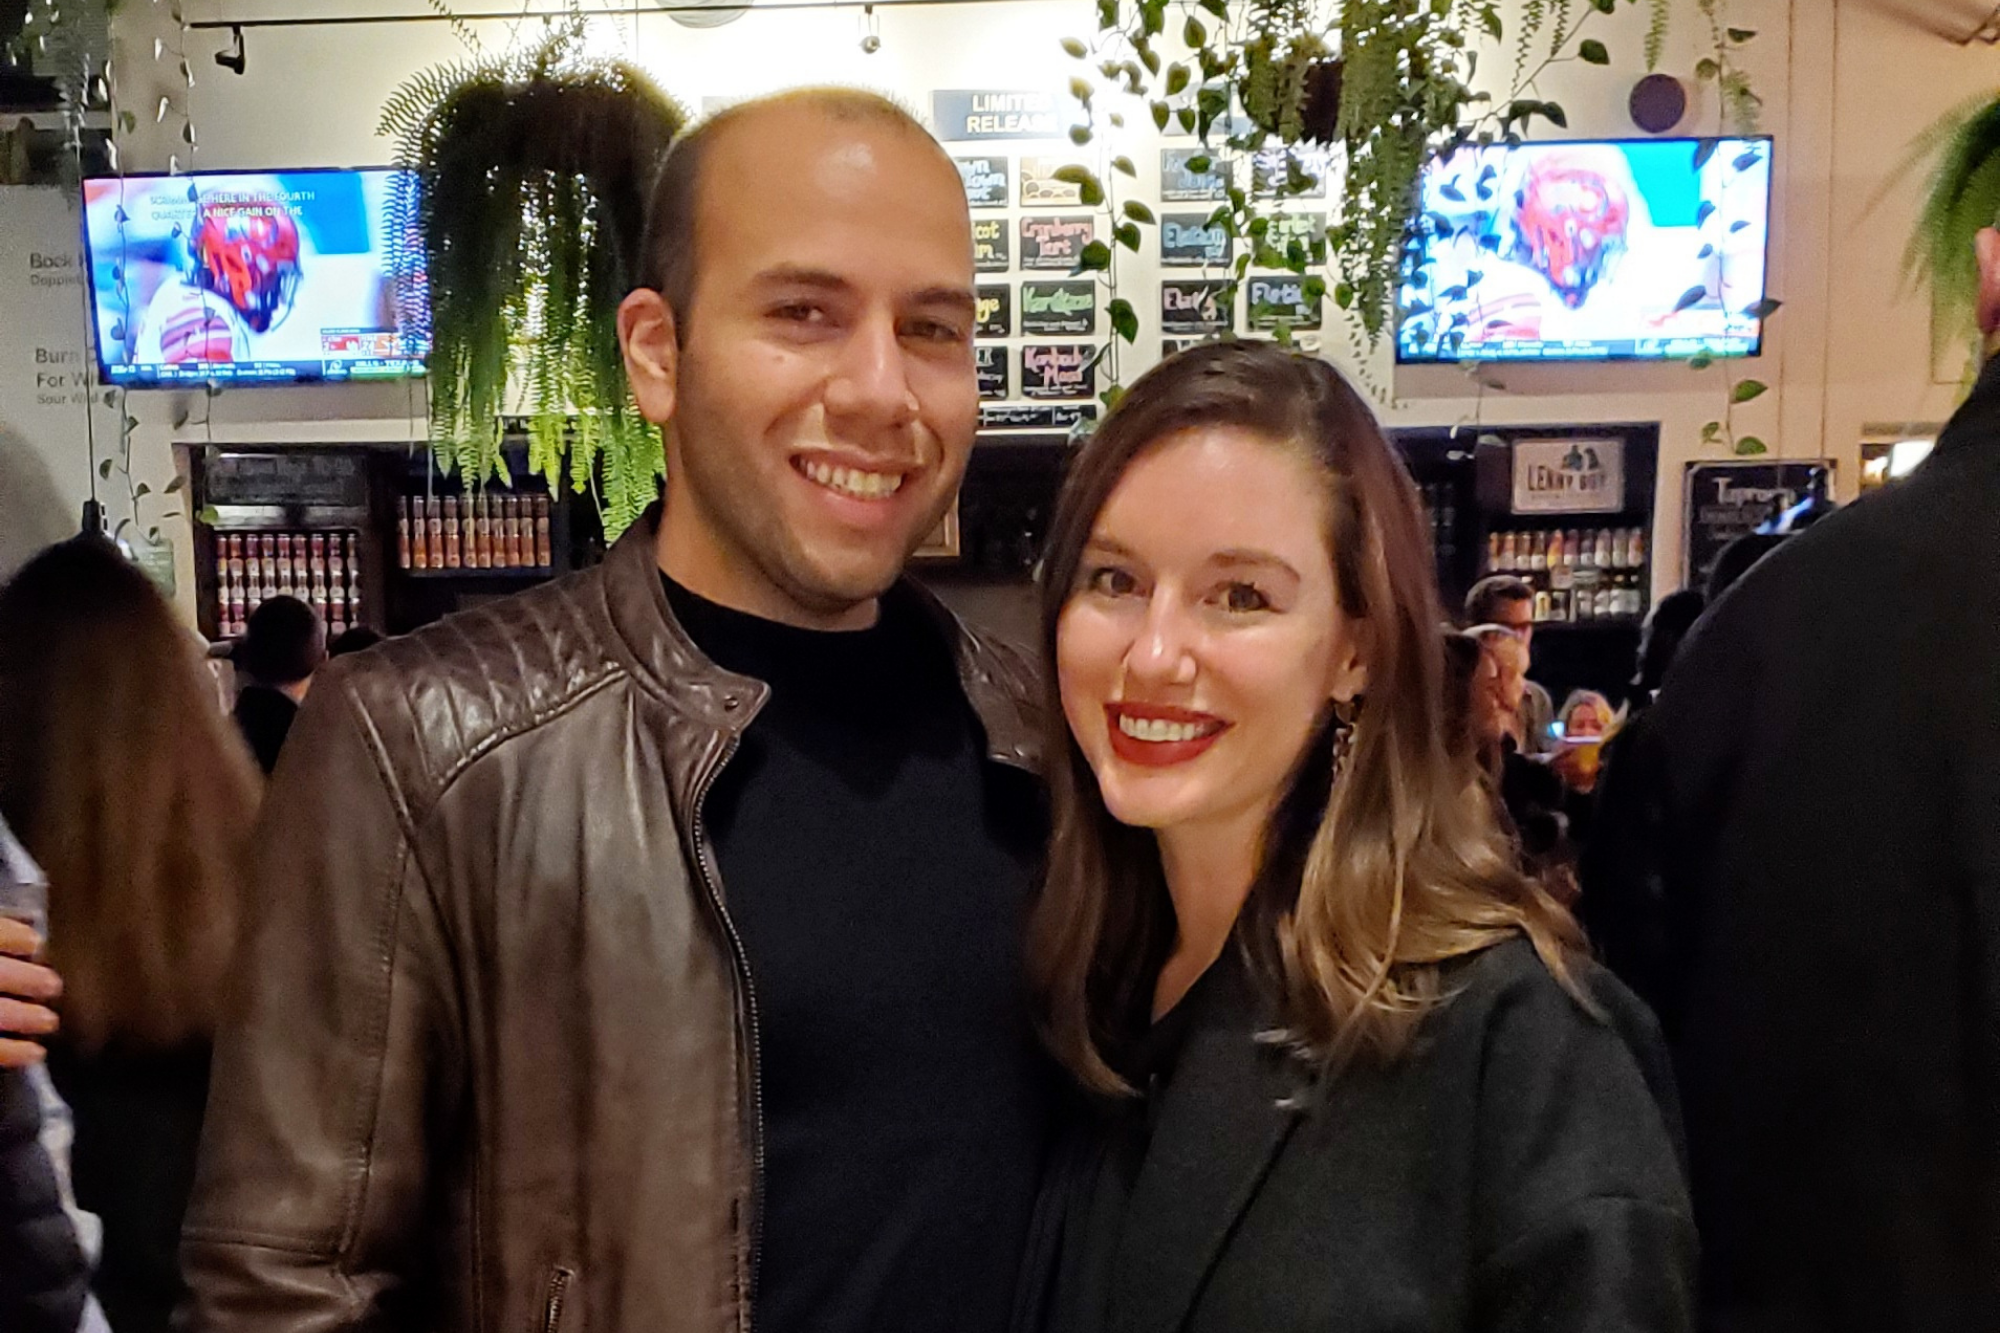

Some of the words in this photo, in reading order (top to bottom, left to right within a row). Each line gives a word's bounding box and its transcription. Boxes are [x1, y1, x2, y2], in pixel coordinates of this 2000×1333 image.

[973, 93, 1054, 113] LIMITED
[966, 114, 1059, 134] RELEASE
[275, 190, 316, 202] FOURTH
[238, 207, 264, 218] GAIN
[284, 205, 303, 216] THE
[36, 371, 66, 388] For
[36, 390, 67, 405] Sour
